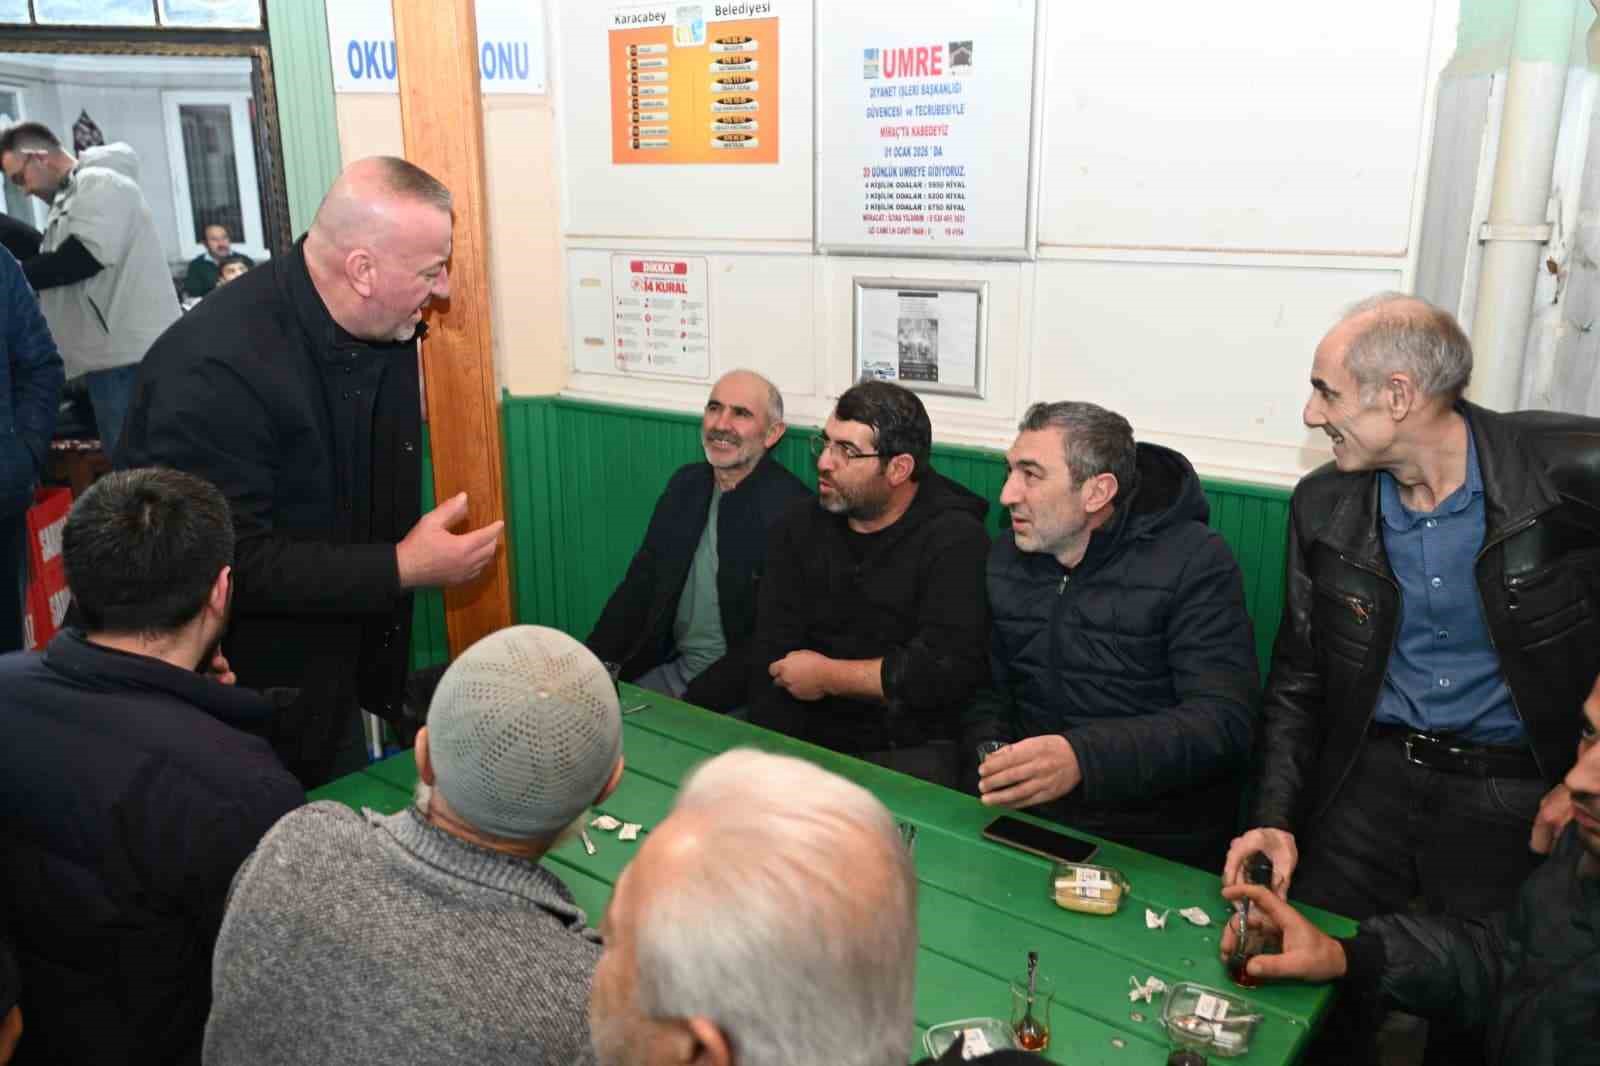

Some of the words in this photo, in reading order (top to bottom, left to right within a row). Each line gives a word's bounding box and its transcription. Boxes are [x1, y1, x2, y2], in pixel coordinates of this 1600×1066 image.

[615, 11, 666, 25] Karacabey
[715, 2, 770, 18] Belediyesi
[348, 40, 397, 79] OKU
[481, 41, 529, 80] ONU
[883, 45, 943, 79] UMRE
[655, 281, 688, 294] KURAL
